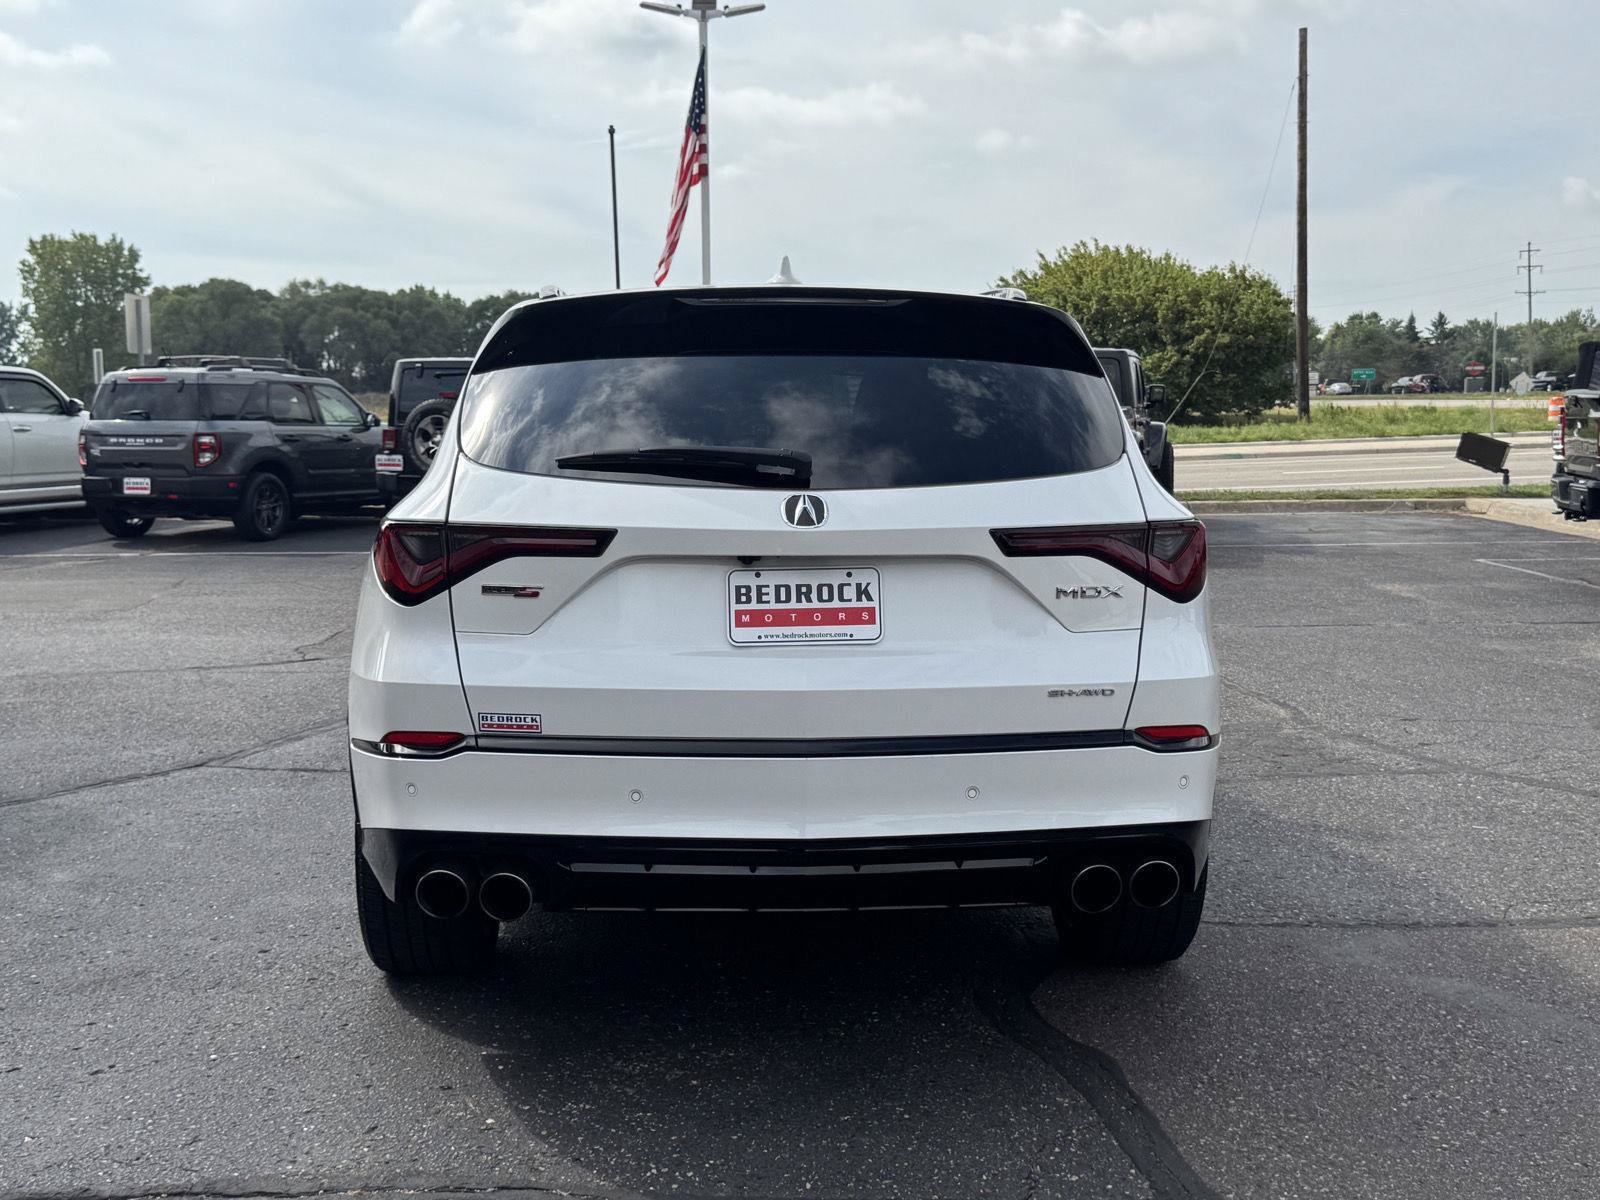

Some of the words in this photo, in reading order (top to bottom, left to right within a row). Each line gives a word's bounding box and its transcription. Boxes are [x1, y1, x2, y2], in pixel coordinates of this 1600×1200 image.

[735, 582, 874, 605] BEDROCK
[1055, 585, 1124, 599] MDX
[741, 612, 869, 623] MOTORS
[763, 631, 848, 640] www.bedrockmotors.com
[481, 715, 539, 724] BEDROCK
